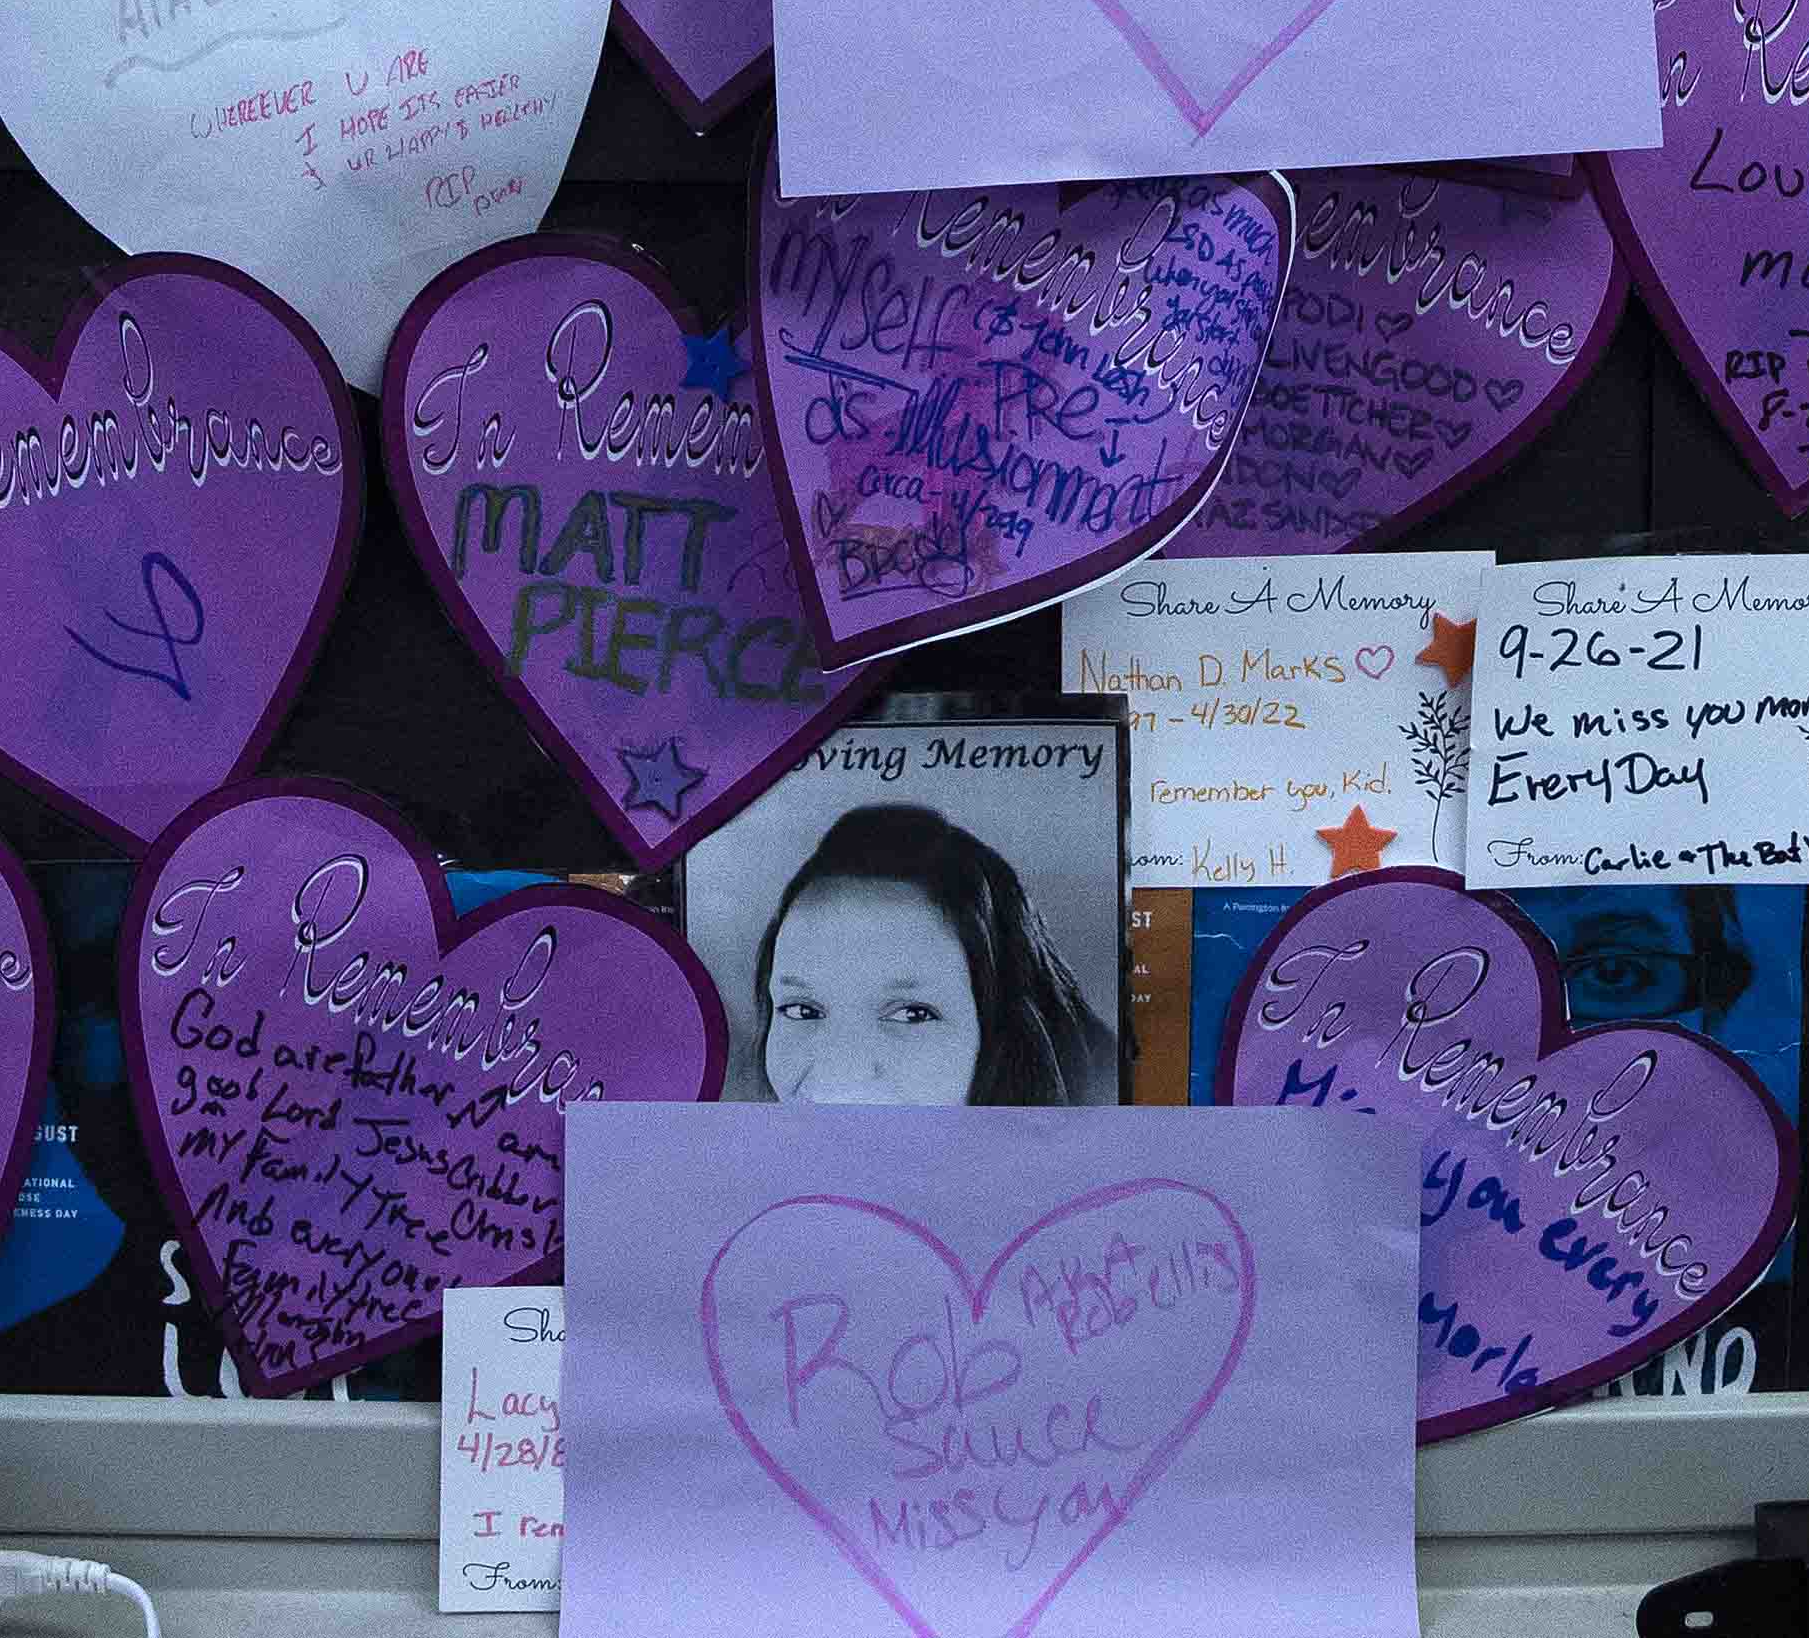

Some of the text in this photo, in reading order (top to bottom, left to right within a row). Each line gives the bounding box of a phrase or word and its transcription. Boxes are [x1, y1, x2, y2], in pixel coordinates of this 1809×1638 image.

[1120, 578, 1221, 618] Share
[1286, 579, 1439, 627] Memory
[1532, 579, 1624, 620] Share
[923, 735, 1104, 781] Memory
[1487, 837, 1584, 871] From:
[151, 864, 245, 987] In
